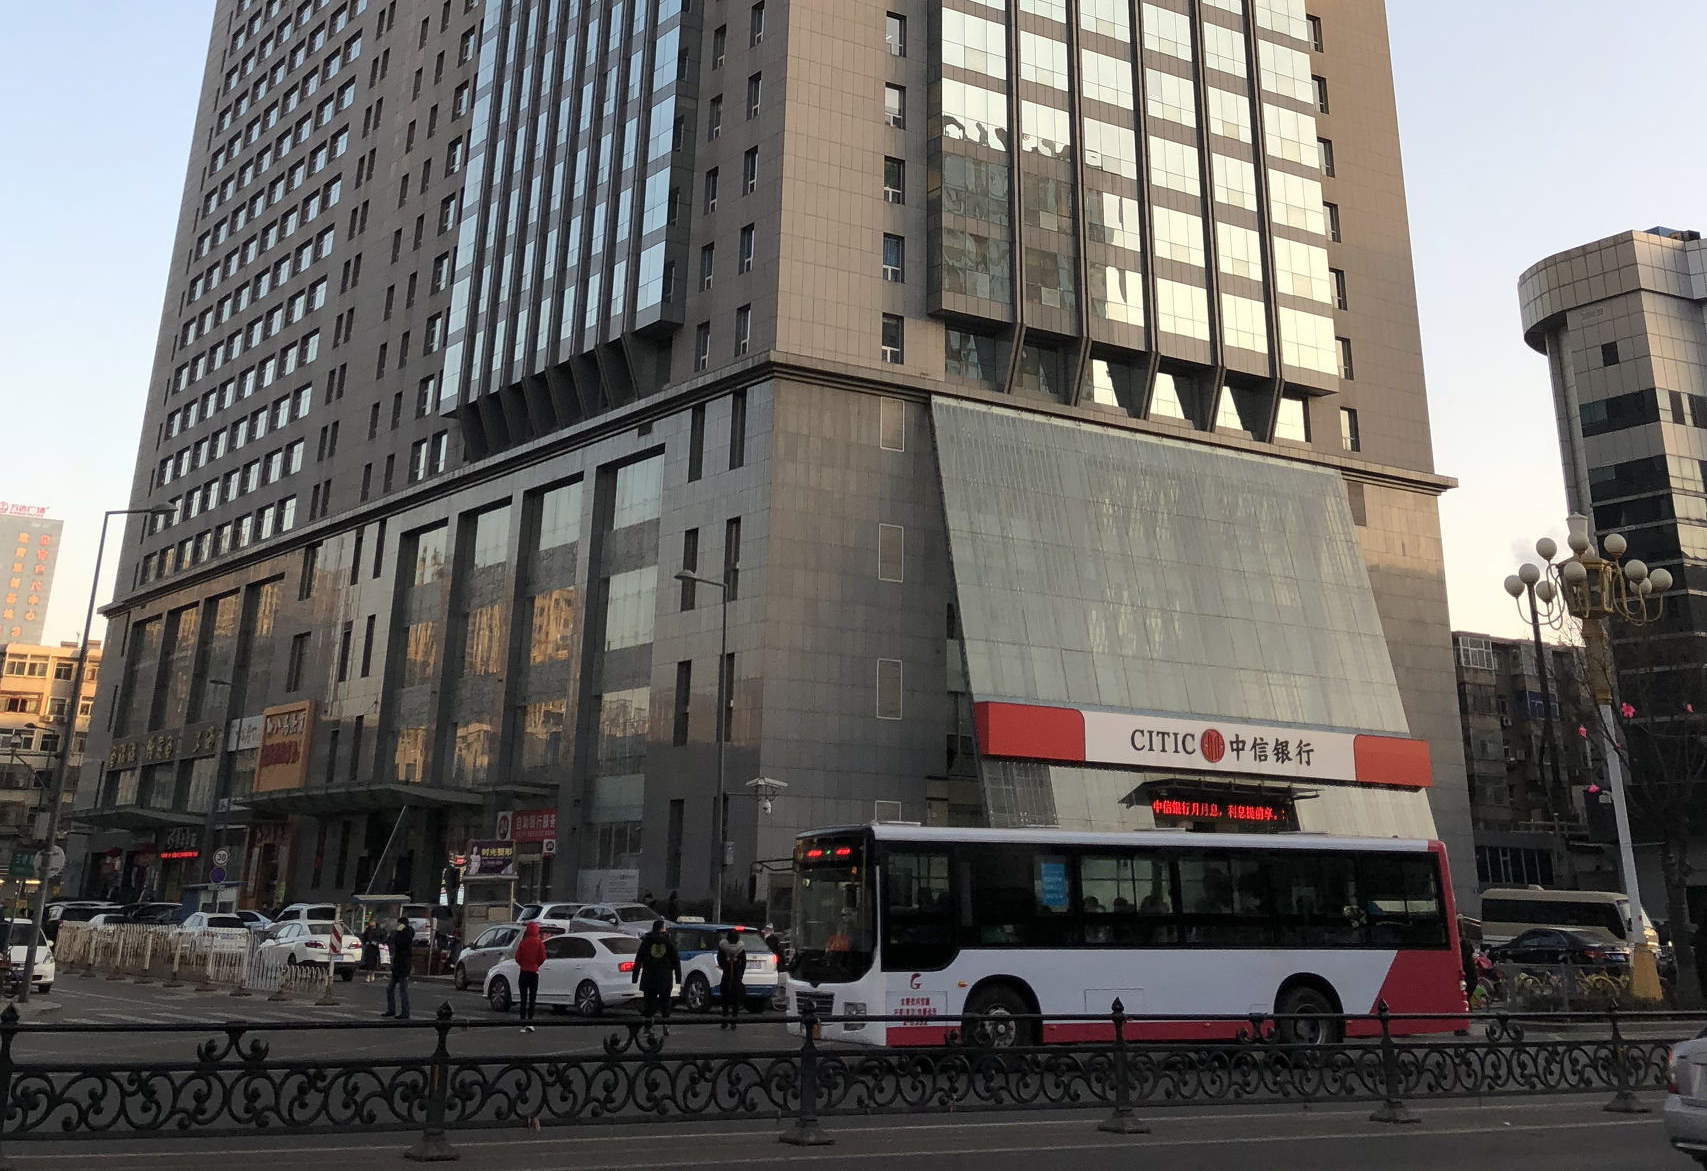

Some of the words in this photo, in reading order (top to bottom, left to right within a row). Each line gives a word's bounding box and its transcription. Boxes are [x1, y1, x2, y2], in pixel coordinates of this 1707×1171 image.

[1130, 729, 1196, 755] CITIC
[1230, 733, 1315, 767] 中信银行
[217, 853, 227, 862] 30
